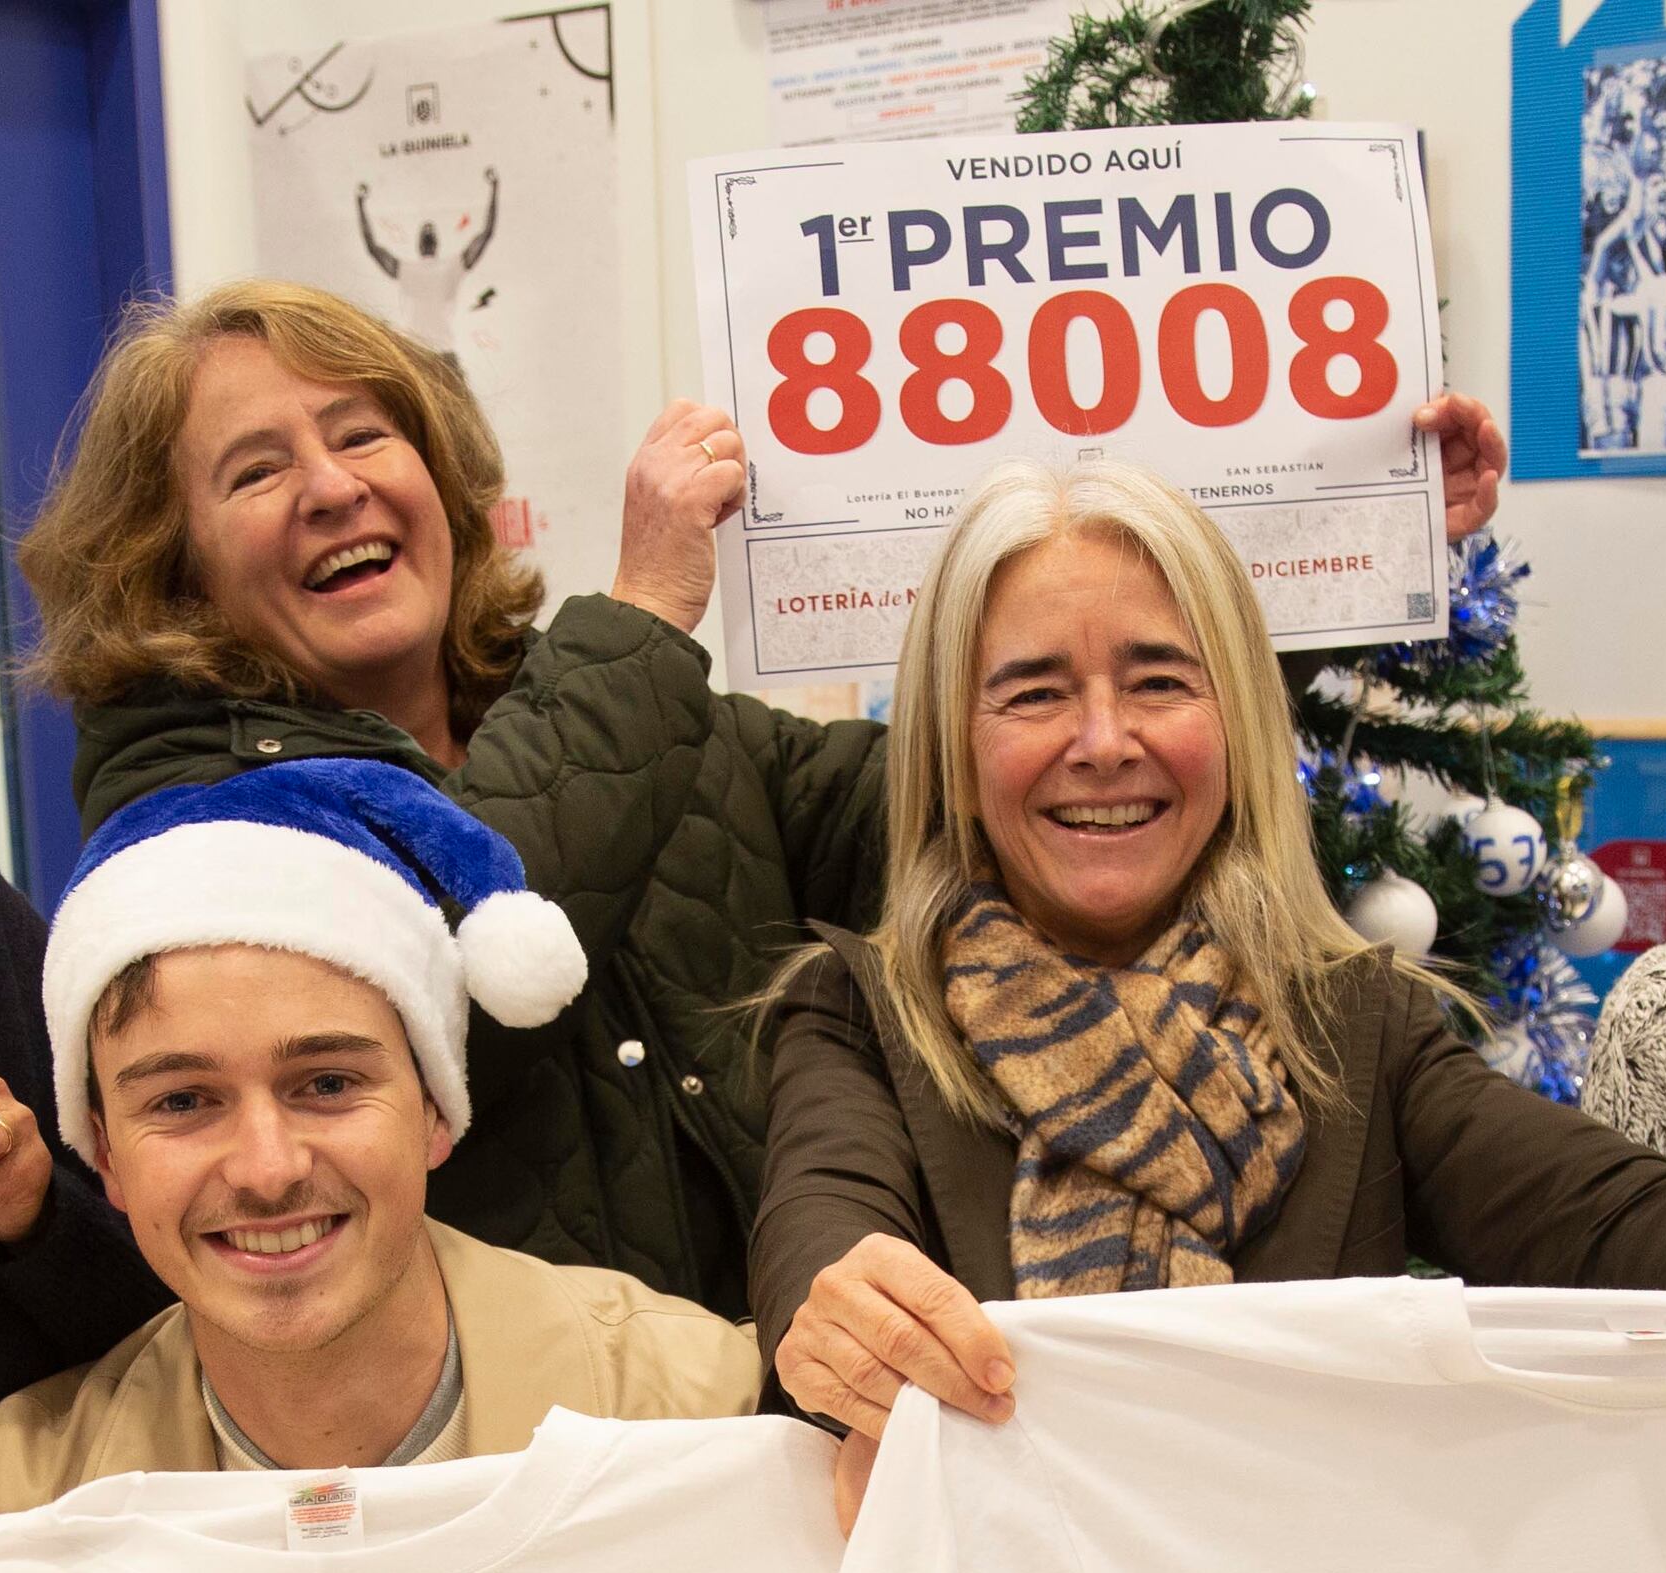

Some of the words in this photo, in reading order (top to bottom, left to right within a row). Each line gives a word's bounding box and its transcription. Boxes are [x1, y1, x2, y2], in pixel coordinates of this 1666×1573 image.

[946, 152, 1092, 182] VENDIDO
[1104, 140, 1183, 174] AQUÍ
[799, 211, 874, 297] 1er
[887, 187, 1332, 293] PREMIO
[766, 275, 1399, 456] 88008
[1226, 467, 1251, 477] SAN
[1256, 462, 1324, 475] SEBASTIAN
[846, 491, 892, 504] Lotería
[897, 490, 909, 500] El
[1190, 482, 1275, 499] TENERNOS
[905, 507, 929, 520] NO
[934, 505, 961, 517] HA
[1251, 554, 1374, 579] DICIEMBRE
[776, 587, 874, 615] LOTERÍA
[878, 591, 902, 608] de
